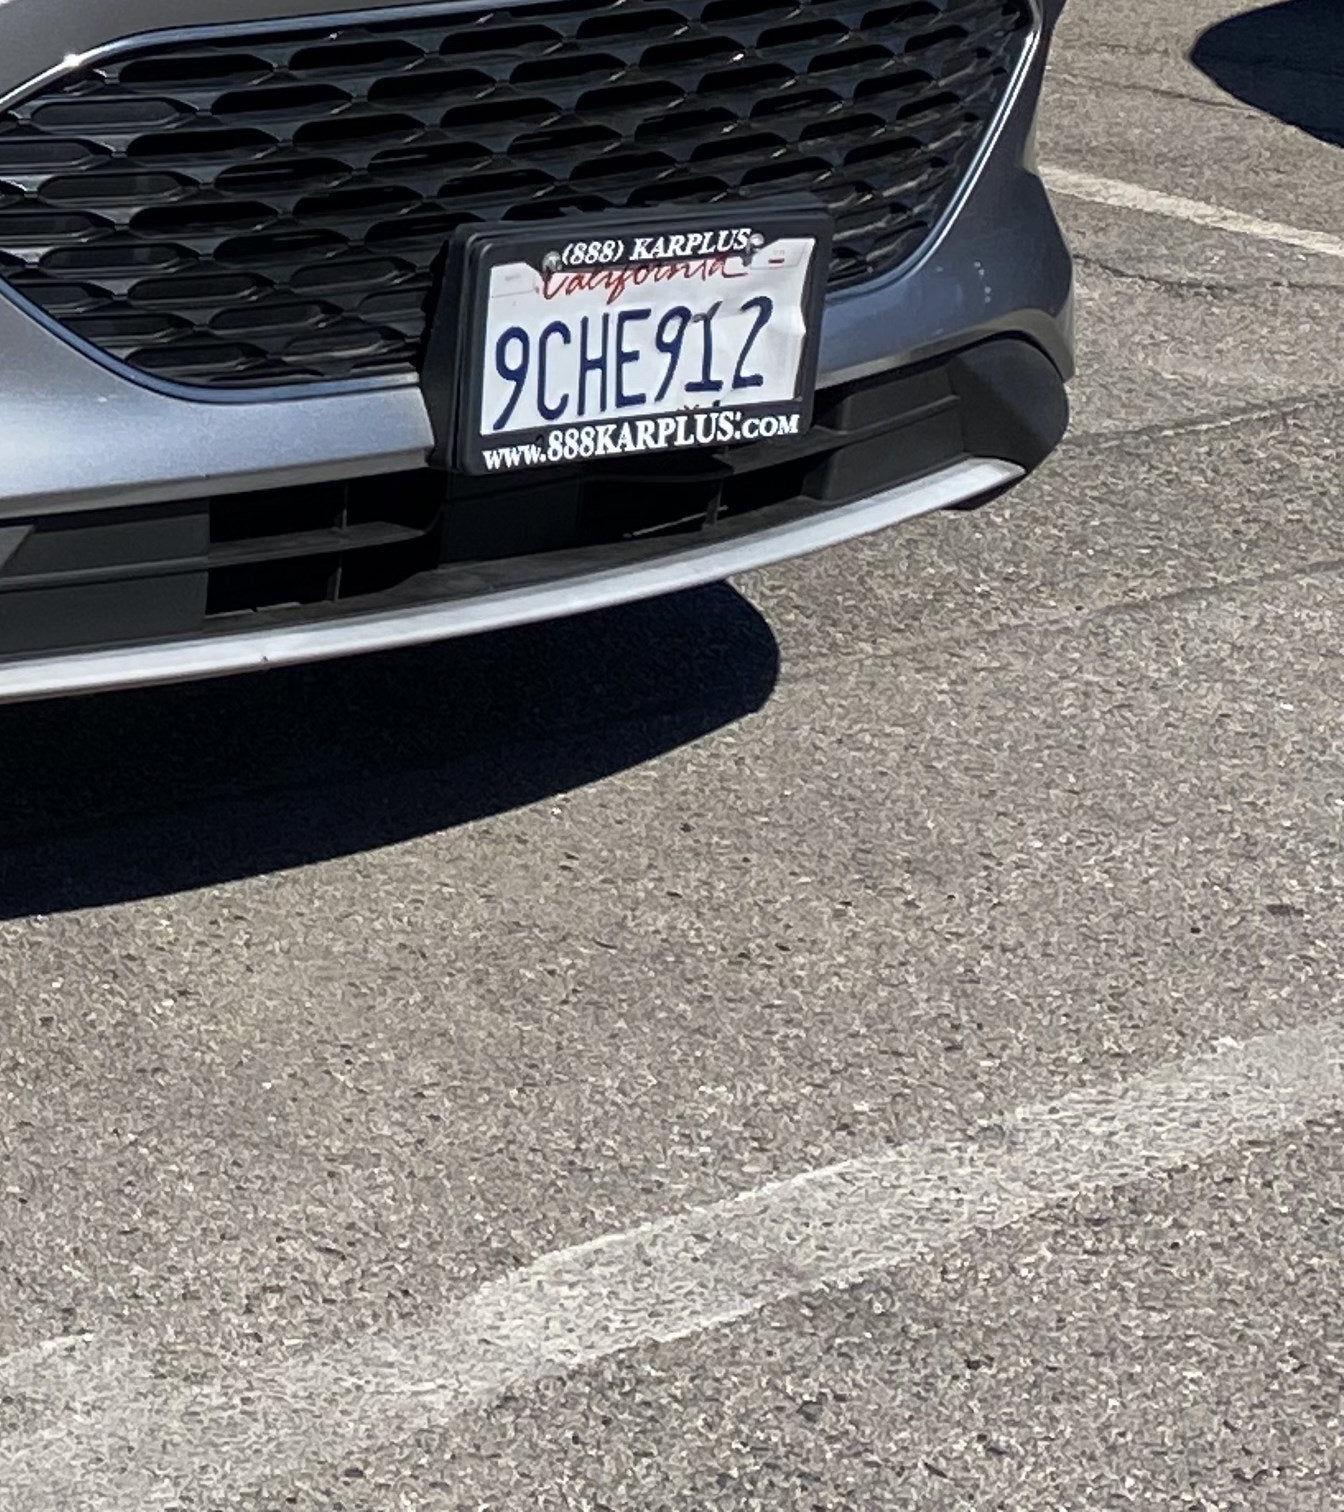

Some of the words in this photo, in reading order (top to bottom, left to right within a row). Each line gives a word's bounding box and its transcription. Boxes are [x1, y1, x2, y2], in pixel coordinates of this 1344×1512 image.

[561, 238, 623, 266] (888)
[629, 228, 752, 262] KARPLUS
[542, 253, 749, 304] California
[492, 295, 774, 430] 9CHE912
